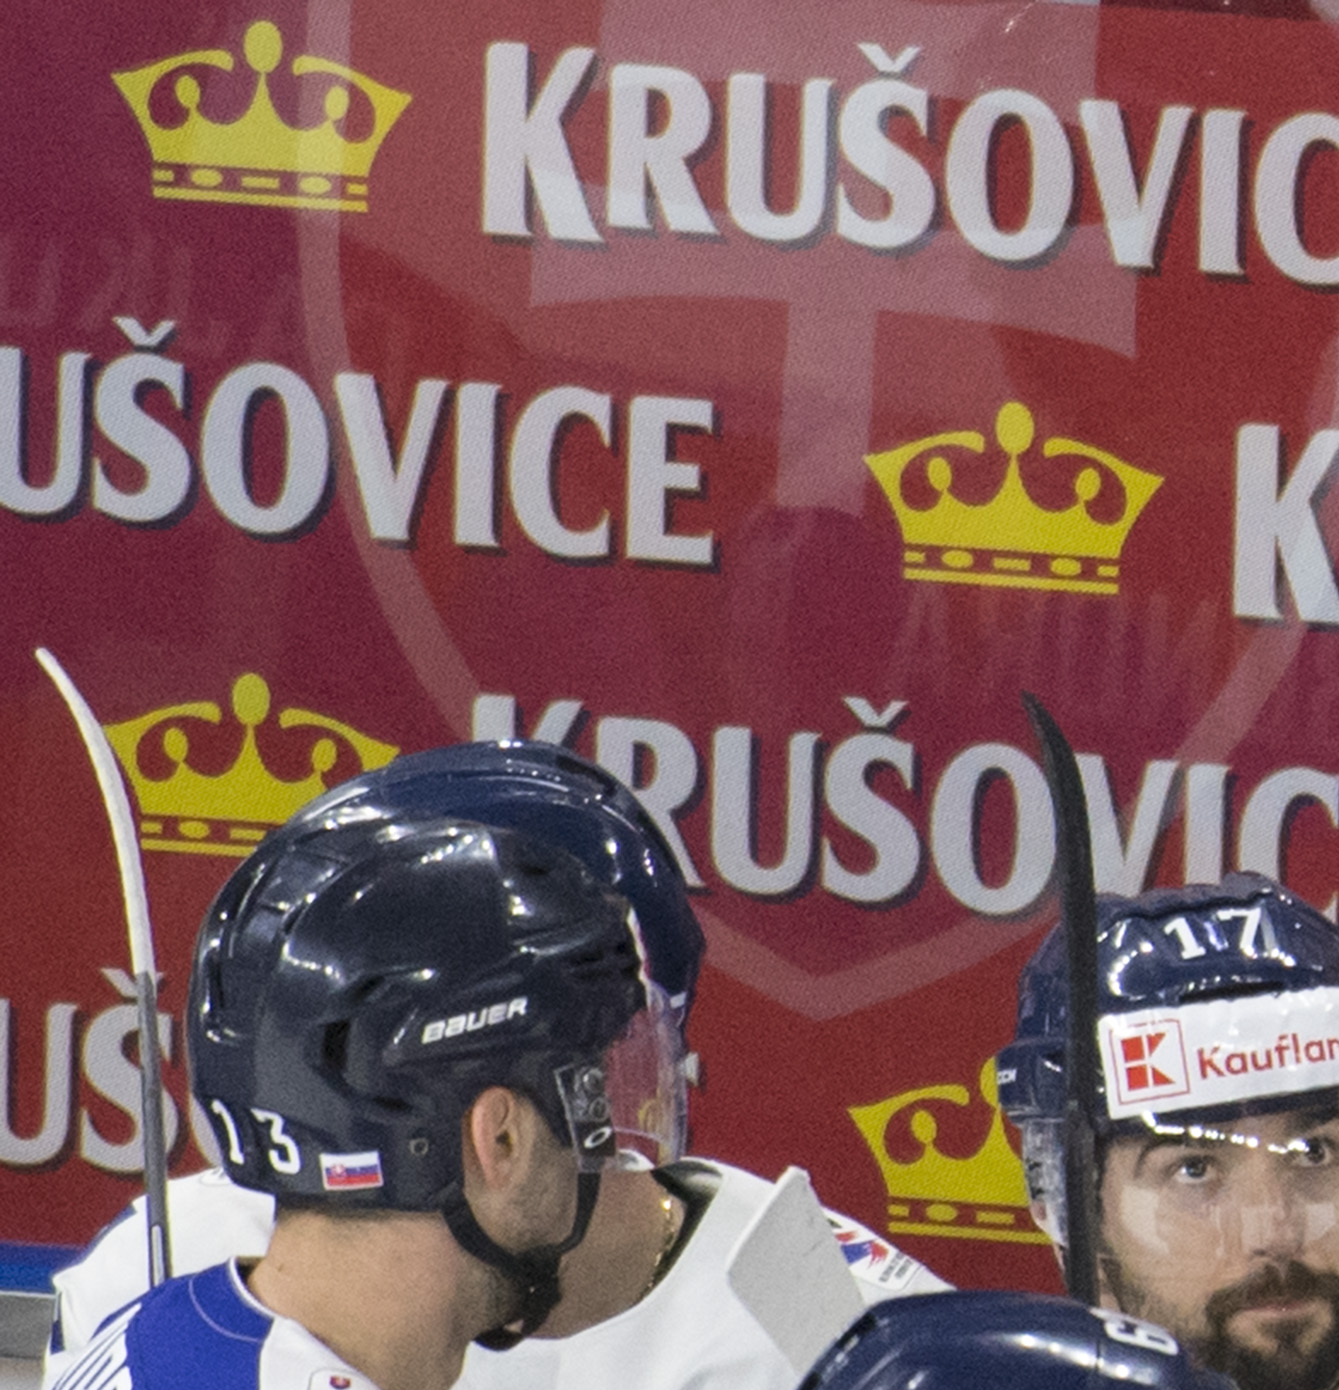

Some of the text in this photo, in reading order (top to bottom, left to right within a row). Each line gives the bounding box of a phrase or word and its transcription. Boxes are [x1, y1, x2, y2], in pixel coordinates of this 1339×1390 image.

[1165, 905, 1264, 961] 17
[421, 996, 528, 1044] BAUER
[211, 1099, 301, 1177] 13
